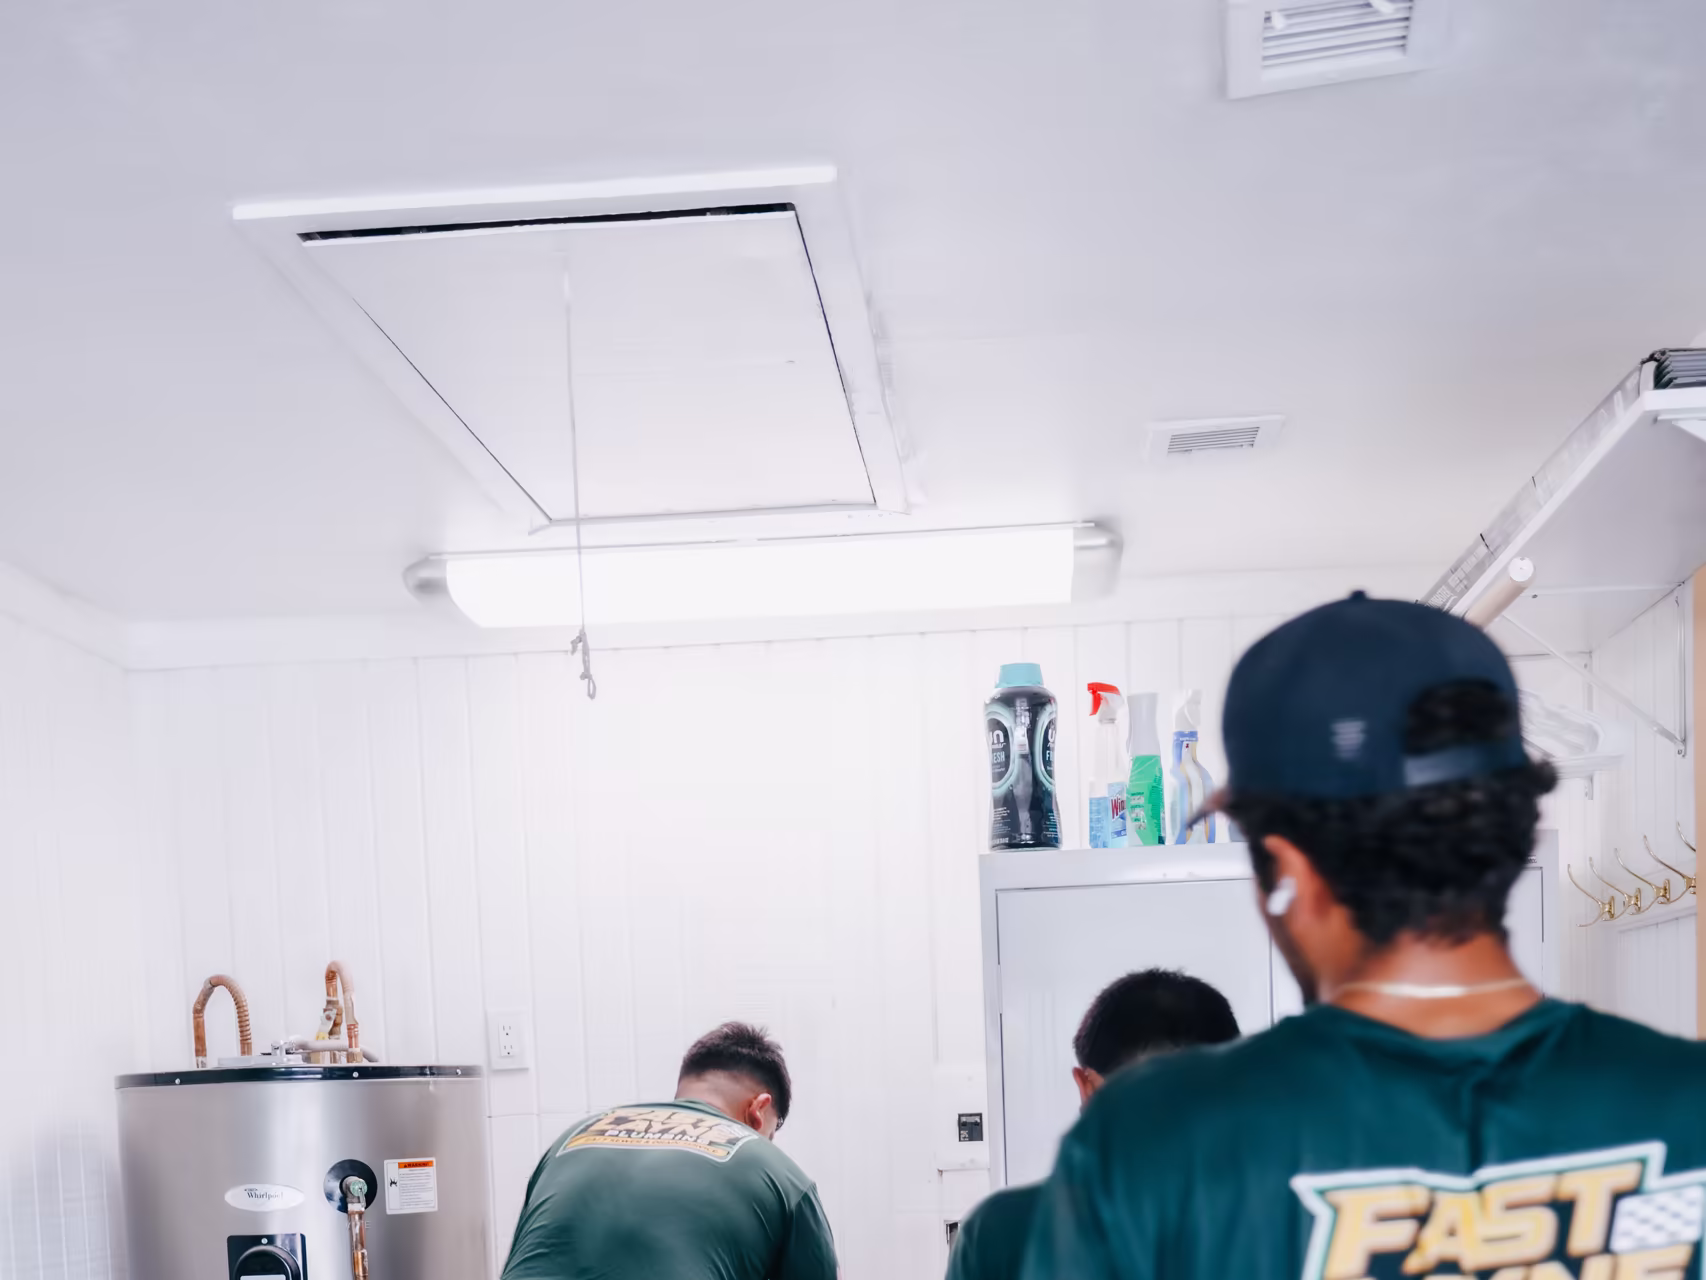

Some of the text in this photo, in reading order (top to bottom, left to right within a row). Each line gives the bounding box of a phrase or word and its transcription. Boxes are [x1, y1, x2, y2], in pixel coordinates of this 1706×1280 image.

[992, 751, 1005, 764] ESH
[1111, 796, 1127, 820] Win
[604, 1130, 710, 1145] PLUMBING
[247, 1191, 283, 1200] Whirlpool
